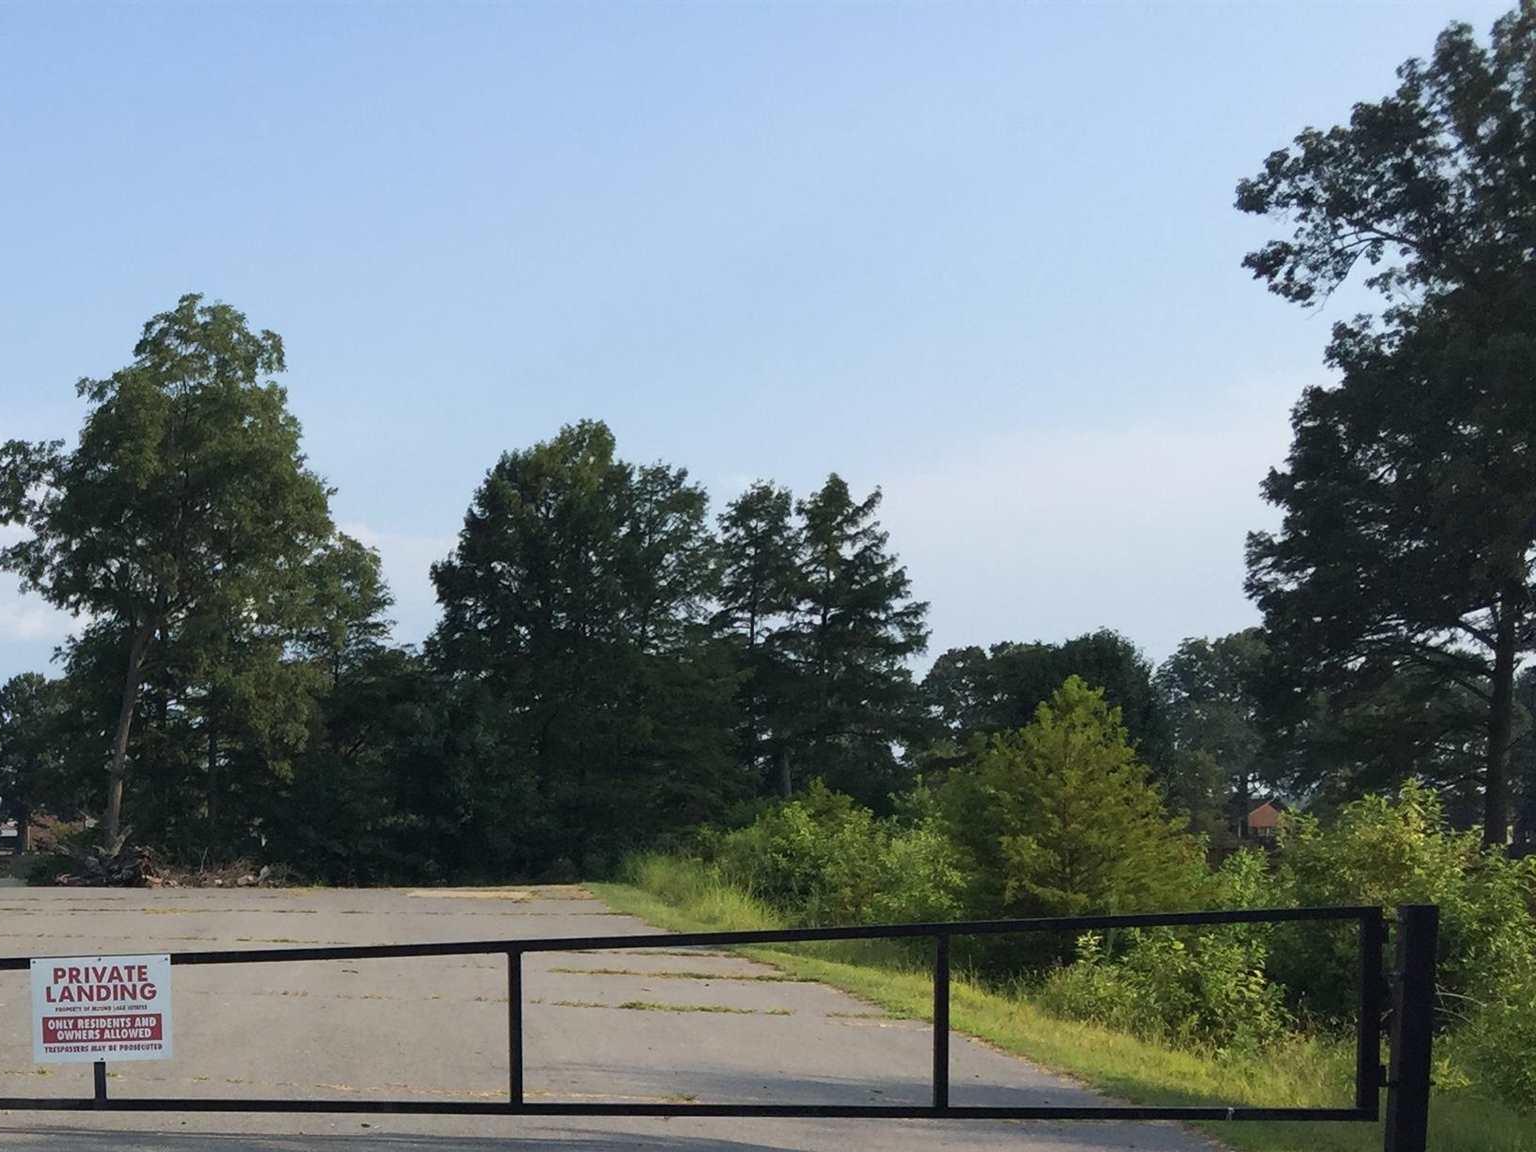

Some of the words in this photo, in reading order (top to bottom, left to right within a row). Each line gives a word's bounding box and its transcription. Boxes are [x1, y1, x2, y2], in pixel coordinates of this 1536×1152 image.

[53, 965, 148, 984] PRIVATE
[46, 983, 157, 1003] LANDING
[48, 1019, 74, 1030] ONLY
[77, 1017, 131, 1029] RESIDENTS
[134, 1017, 156, 1027] AND
[57, 1030, 100, 1040] OWNERS
[104, 1028, 152, 1039] ALLOWED
[44, 1046, 89, 1054] TRESPASSERS
[119, 1043, 163, 1051] PROSECUTED
